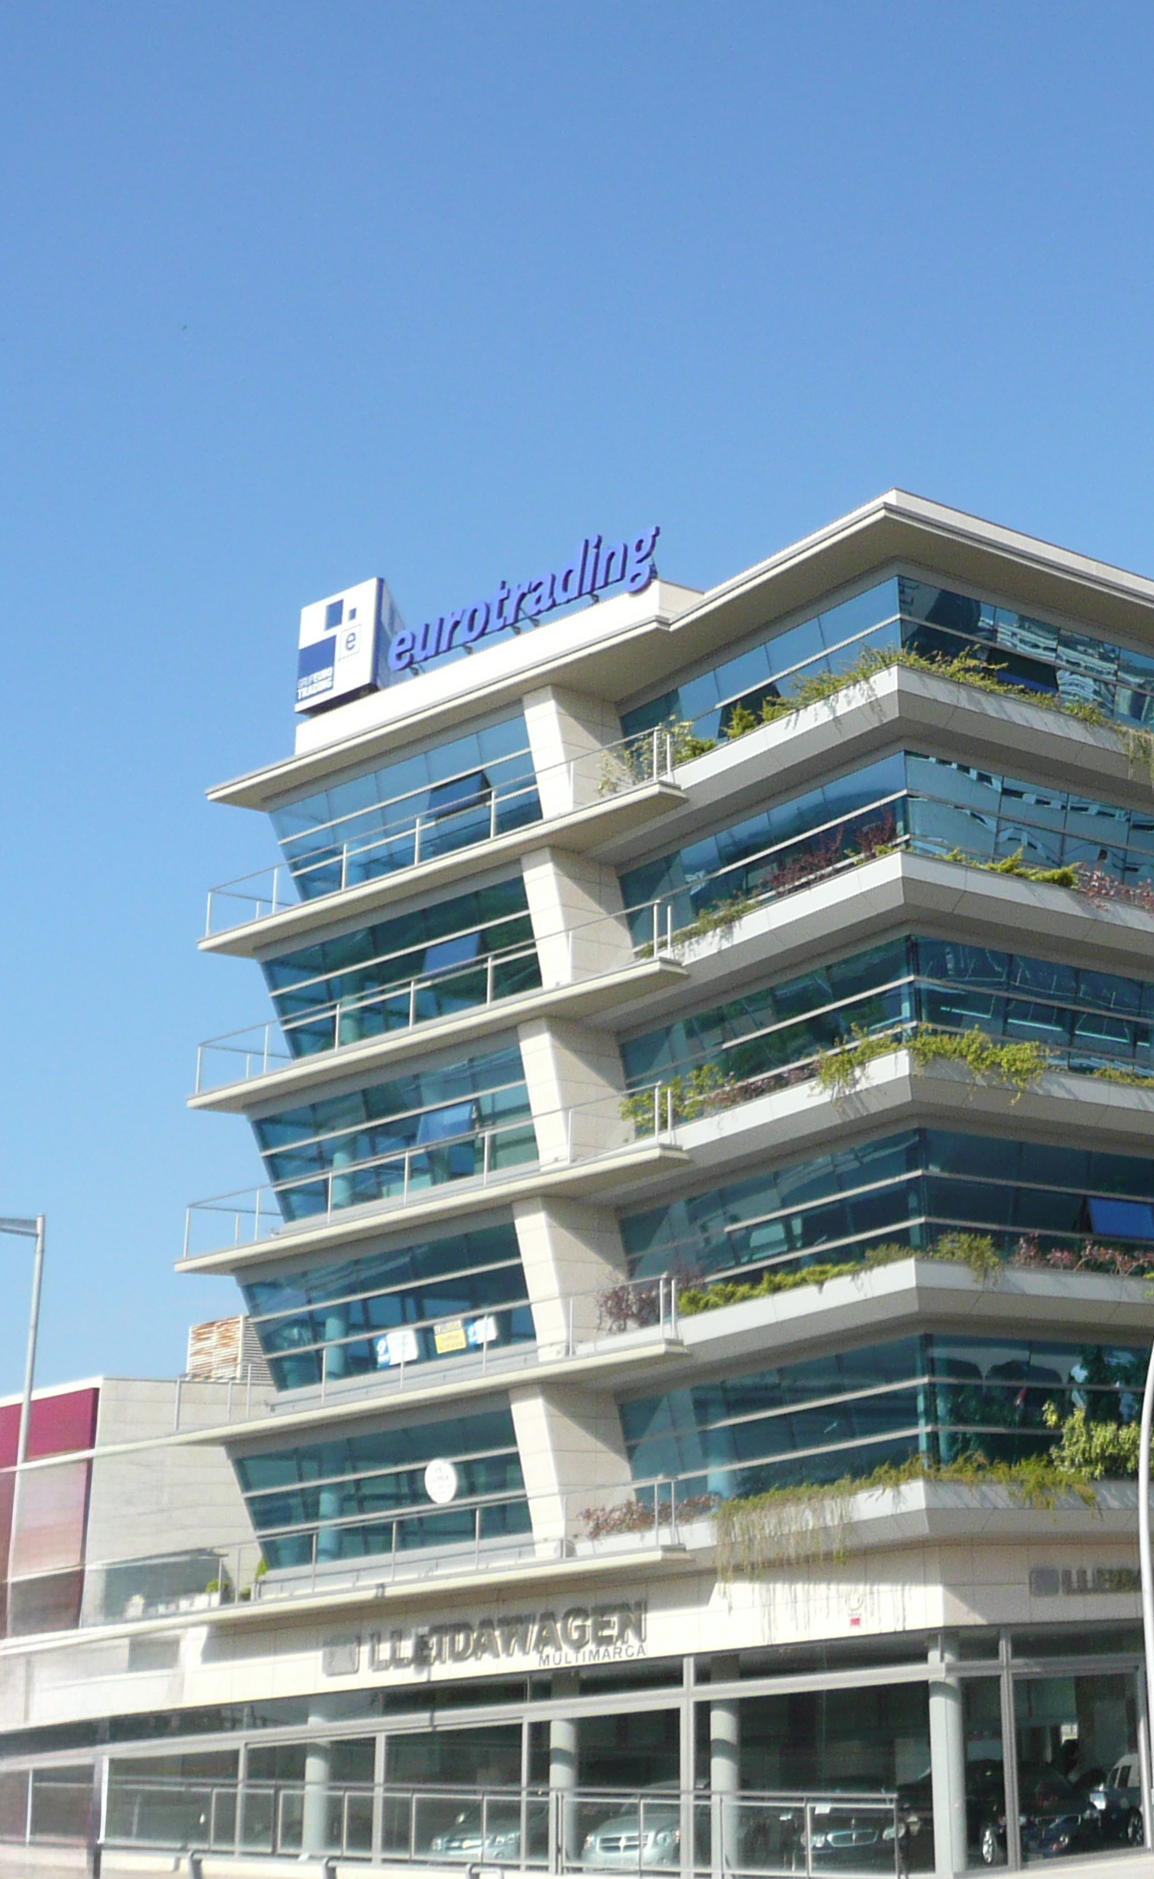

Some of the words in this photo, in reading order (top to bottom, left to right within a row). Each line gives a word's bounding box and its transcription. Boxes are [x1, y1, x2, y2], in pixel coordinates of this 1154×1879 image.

[388, 526, 660, 671] eurotrading
[345, 632, 357, 651] e
[538, 1644, 647, 1667] MULTIMARCA
